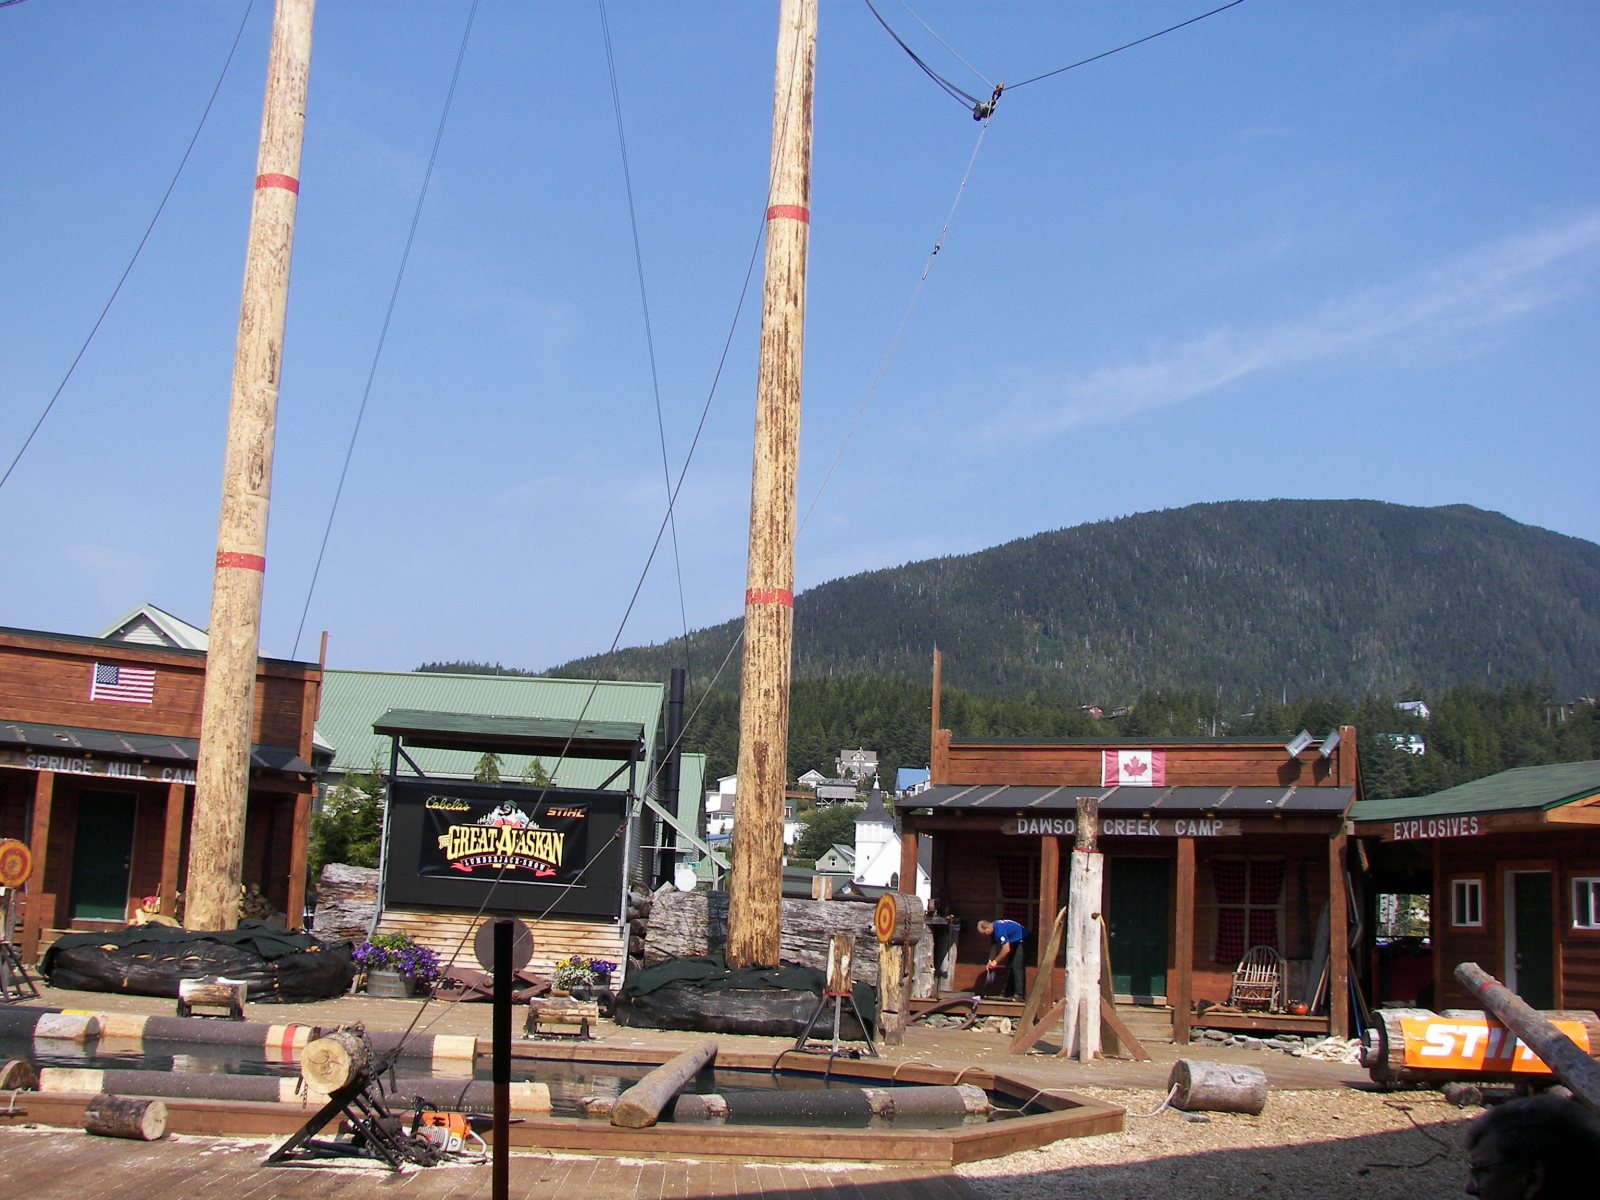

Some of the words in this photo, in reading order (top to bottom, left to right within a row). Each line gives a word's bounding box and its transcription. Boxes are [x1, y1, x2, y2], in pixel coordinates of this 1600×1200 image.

[26, 754, 94, 774] SPRUCE
[107, 762, 148, 780] MILL
[161, 767, 197, 785] CAM
[425, 795, 471, 812] Cabela's
[547, 806, 585, 818] STIHL
[1017, 819, 1076, 835] DAWSO
[1103, 819, 1161, 836] CREEK
[1175, 819, 1223, 836] CAMP
[1393, 816, 1480, 841] EXPLOSIVES
[446, 825, 498, 860] GREAT
[495, 824, 565, 867] ALASKAN
